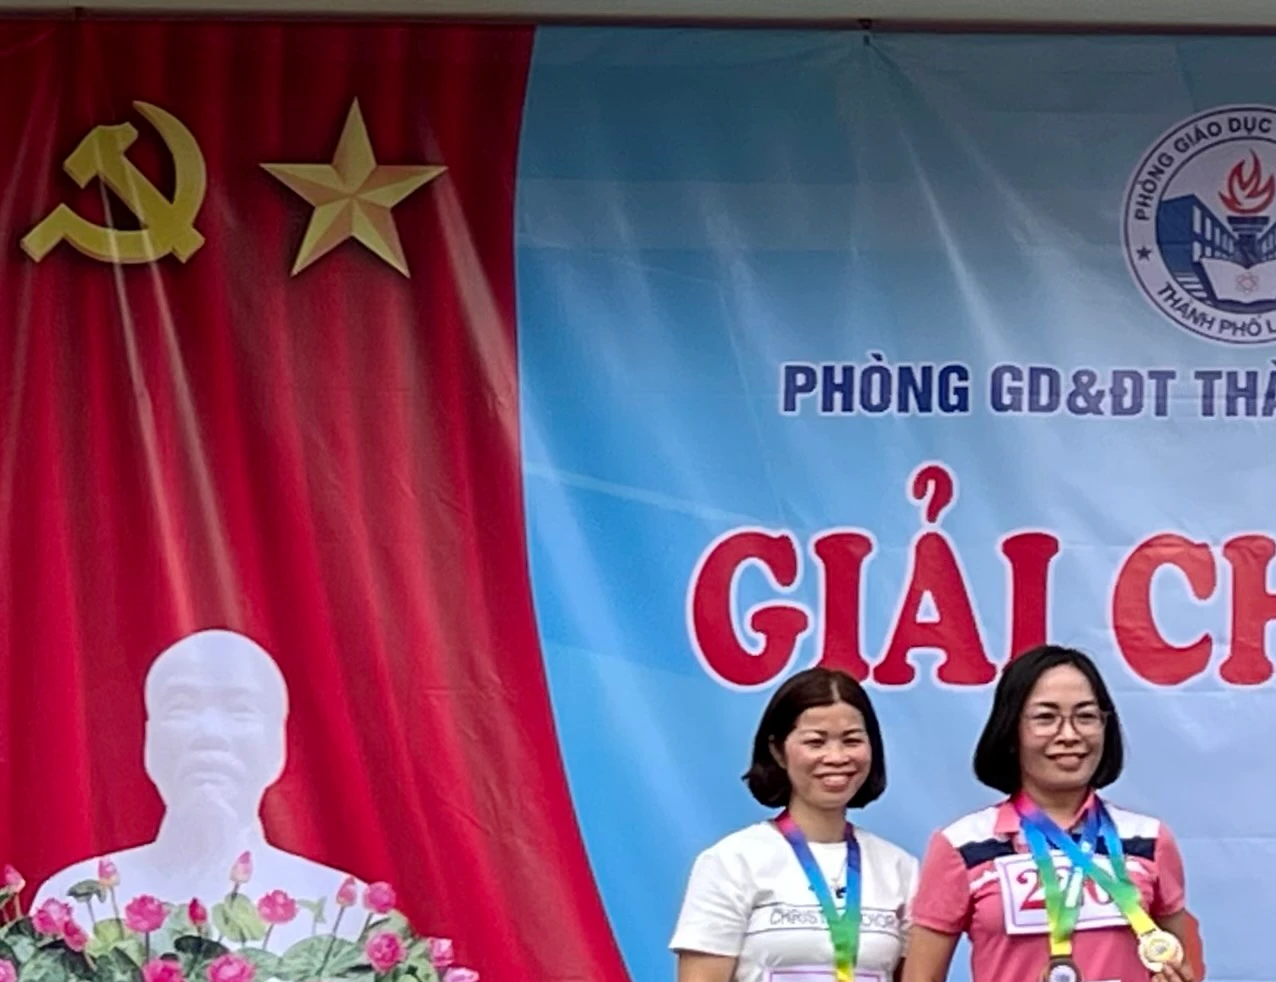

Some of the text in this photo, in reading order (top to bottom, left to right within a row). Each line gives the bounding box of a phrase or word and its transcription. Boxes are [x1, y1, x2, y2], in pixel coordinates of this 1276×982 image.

[1134, 152, 1175, 221] PHÒNG
[1174, 121, 1222, 155] GIÁO
[1228, 116, 1272, 136] DỤC
[784, 353, 970, 414] PHÒNG
[990, 366, 1176, 417] GD&ĐT
[693, 465, 1059, 686] GIẢI
[1016, 865, 1115, 912] 20
